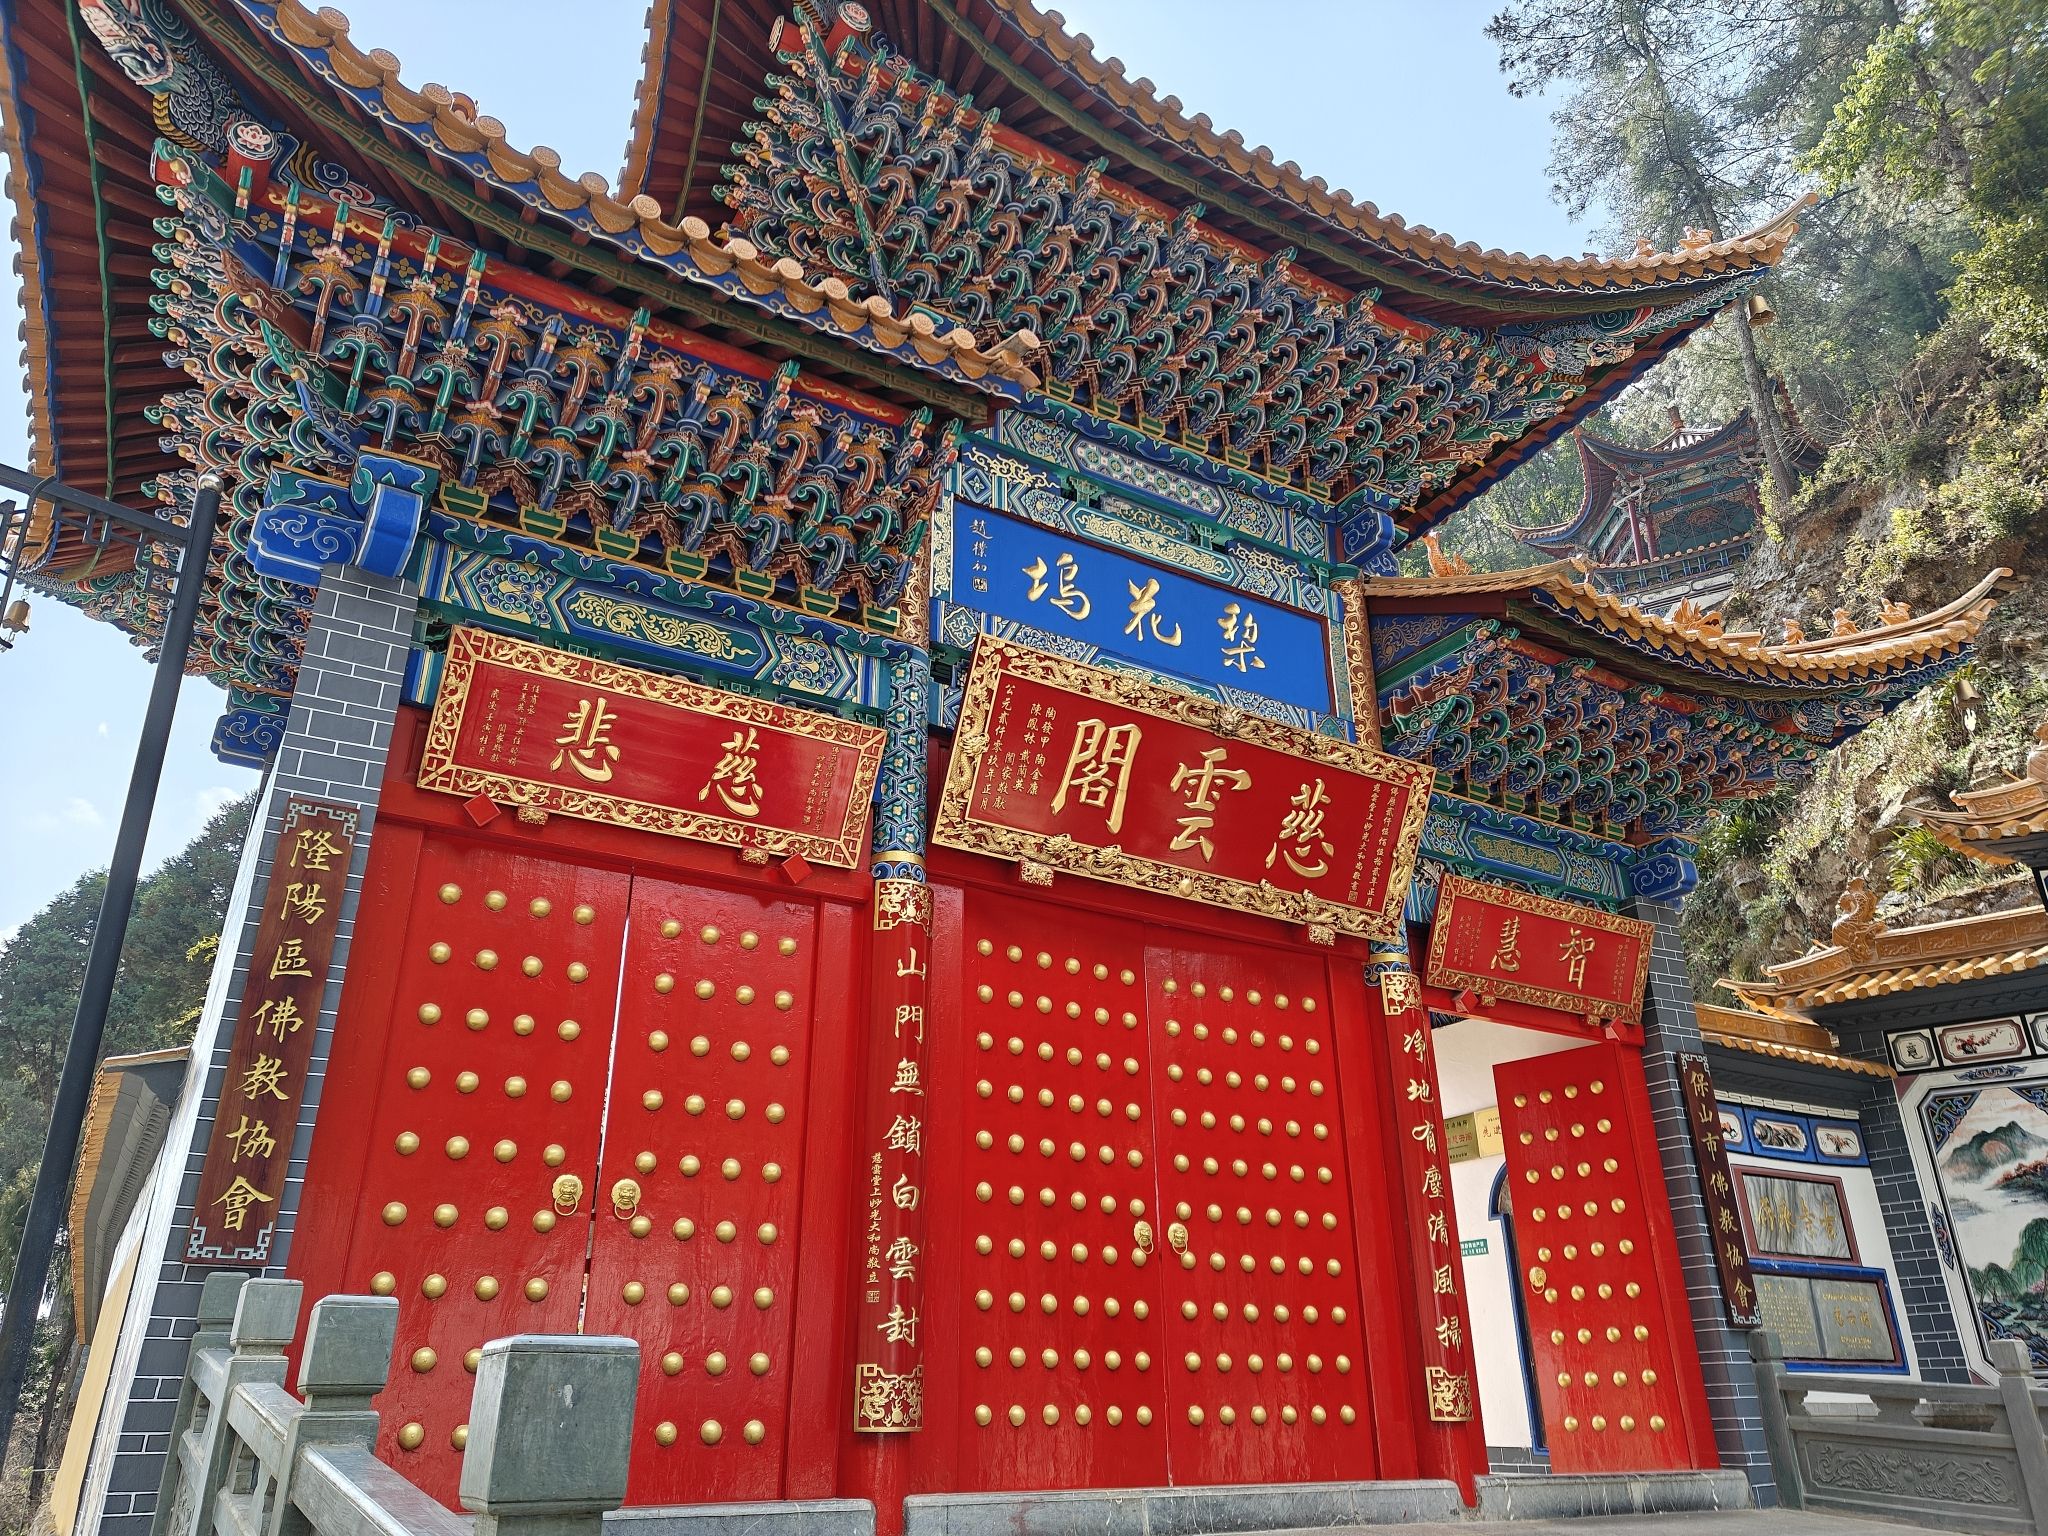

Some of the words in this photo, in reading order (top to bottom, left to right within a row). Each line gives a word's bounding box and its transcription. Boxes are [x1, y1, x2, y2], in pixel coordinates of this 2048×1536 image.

[549, 697, 764, 818] 慈悲
[1051, 718, 1335, 880] 慈雲閣
[211, 828, 343, 1232] 隆陽區佛教協會
[1491, 916, 1595, 990] 智慧
[877, 947, 926, 1348] 山門無鎖白雲封
[1690, 1070, 1753, 1308] 保山市佛教協會
